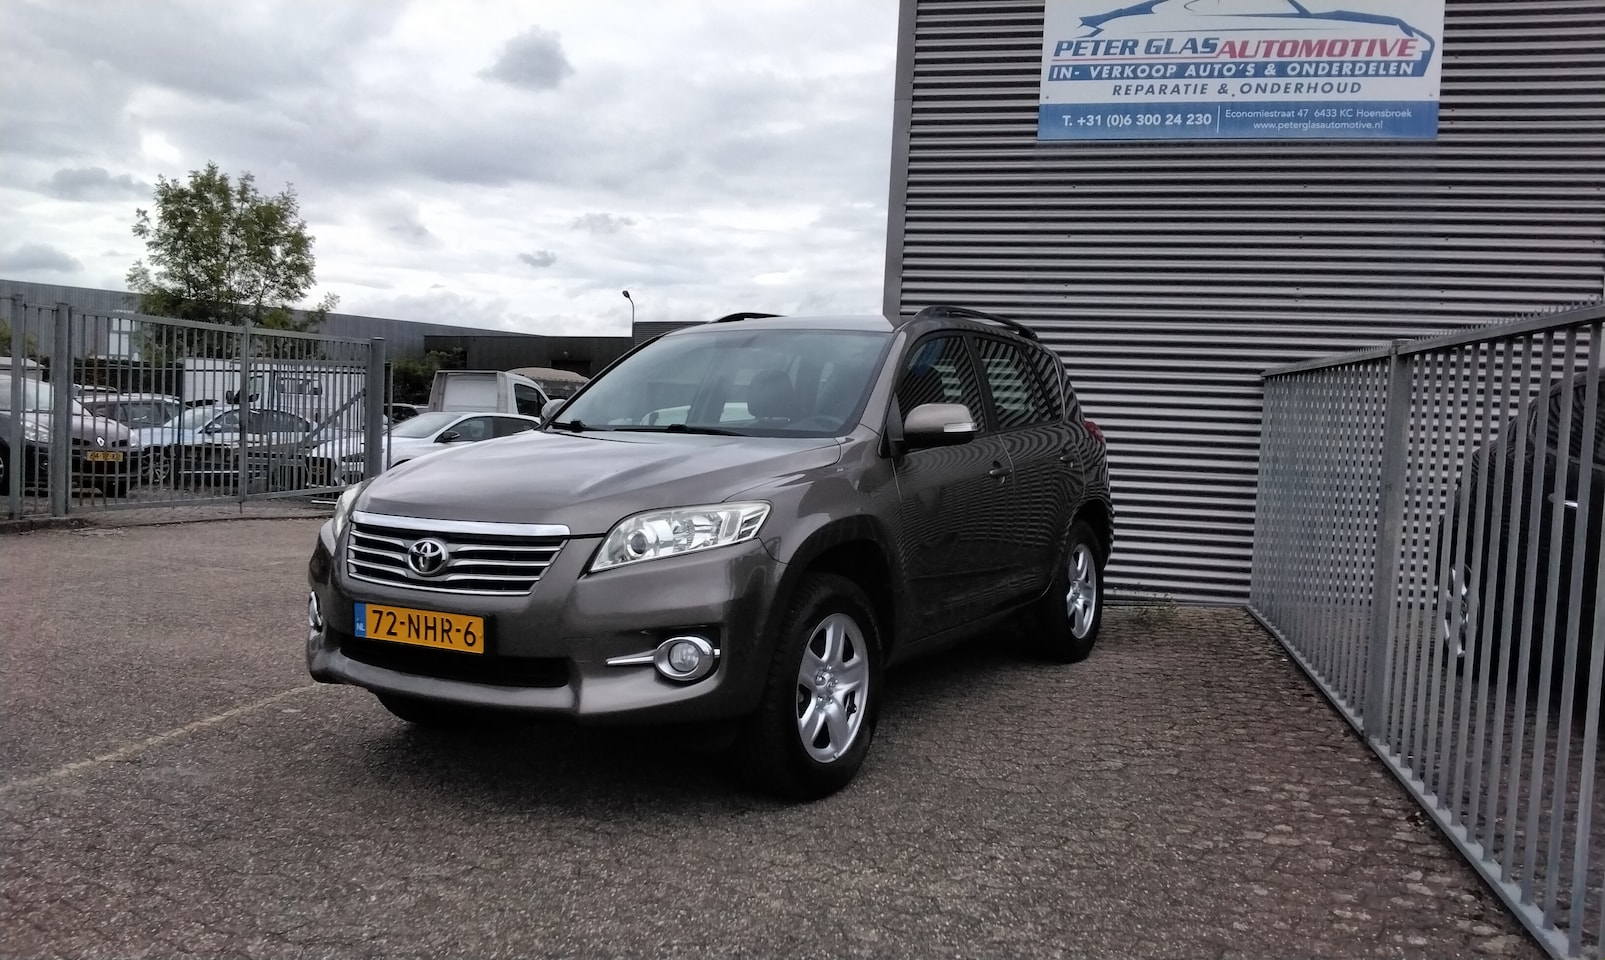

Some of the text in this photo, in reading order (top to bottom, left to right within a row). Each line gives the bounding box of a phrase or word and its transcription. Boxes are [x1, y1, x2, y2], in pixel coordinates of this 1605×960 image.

[1053, 39, 1139, 57] PETER
[1052, 62, 1414, 79] IN- VERKOOP AUTO'S & ONDERDELEN
[1112, 82, 1362, 96] REPARATIE & ONDERHOUD
[1225, 108, 1412, 118] Economiestraat 47 6433 KC Hoensbroek
[1062, 113, 1213, 128] T. +31 (0)6 300 24 230
[1253, 120, 1383, 131] www.peterglasautomotive.nl
[356, 622, 366, 632] NL
[371, 609, 477, 648] 72-NHR-6
